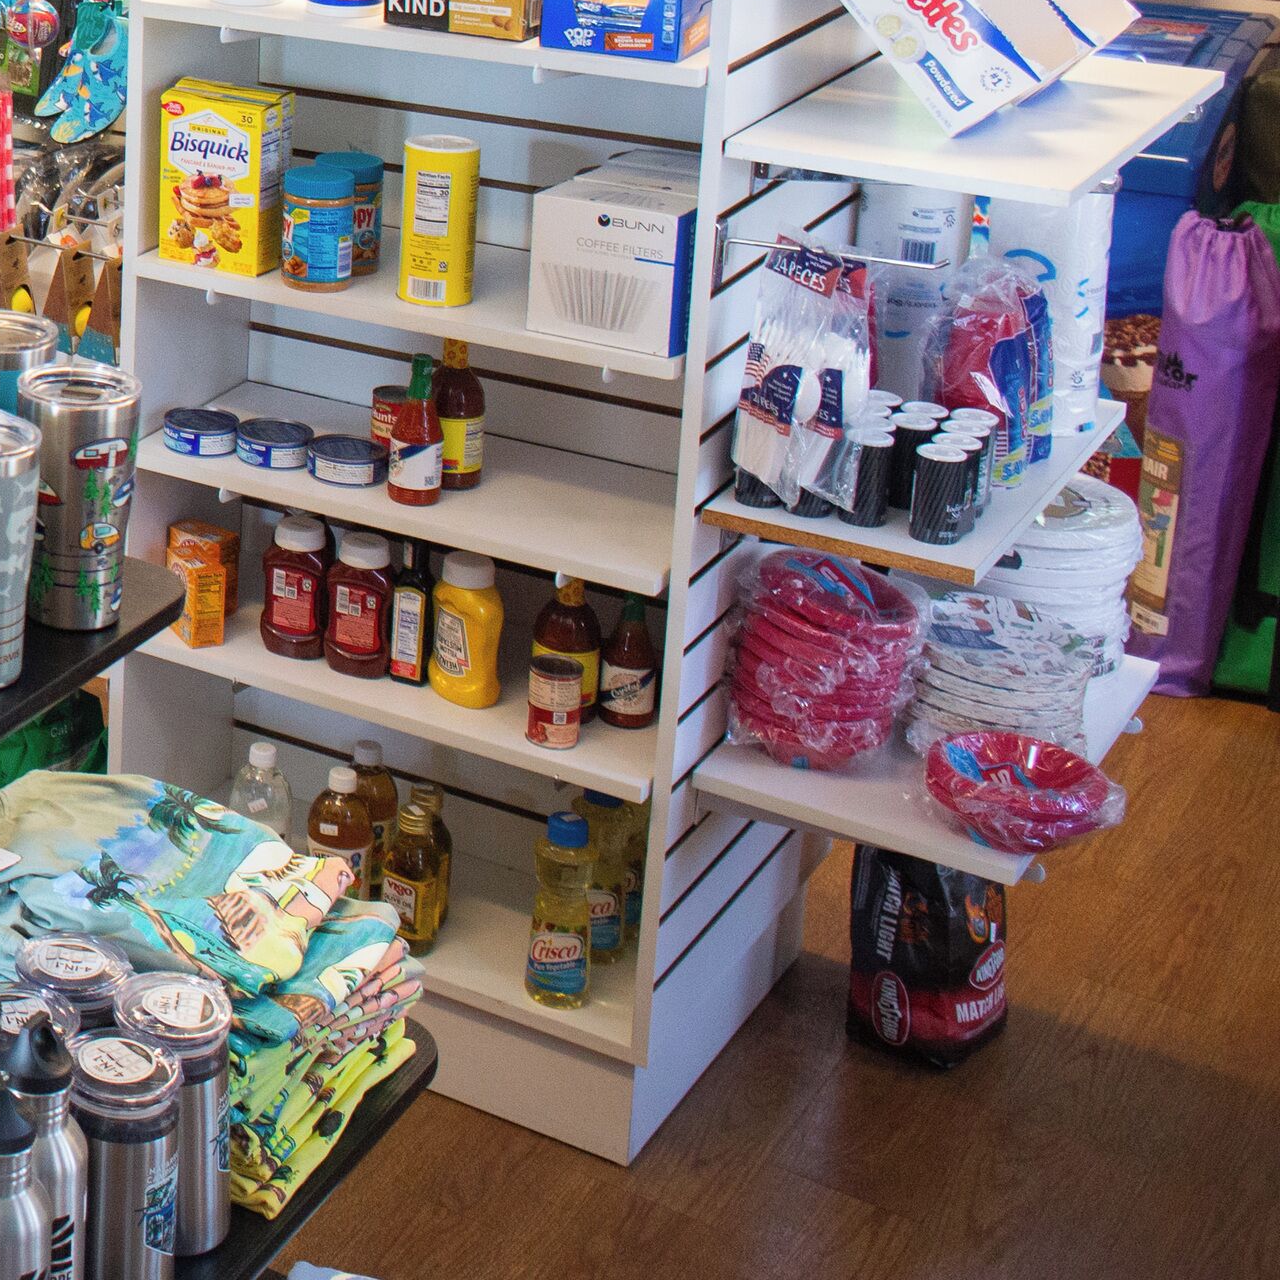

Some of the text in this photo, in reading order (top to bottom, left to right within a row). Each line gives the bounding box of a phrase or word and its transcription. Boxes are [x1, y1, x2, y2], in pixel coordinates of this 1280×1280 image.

[924, 61, 967, 107] Powdered
[989, 73, 1004, 86] #1
[241, 115, 252, 124] 30
[192, 125, 226, 135] ORIGINAL
[170, 131, 249, 164] Bisquick
[612, 217, 665, 234] BUNN
[577, 237, 663, 259] COFFEE FILTERS
[532, 938, 577, 960] Crisco
